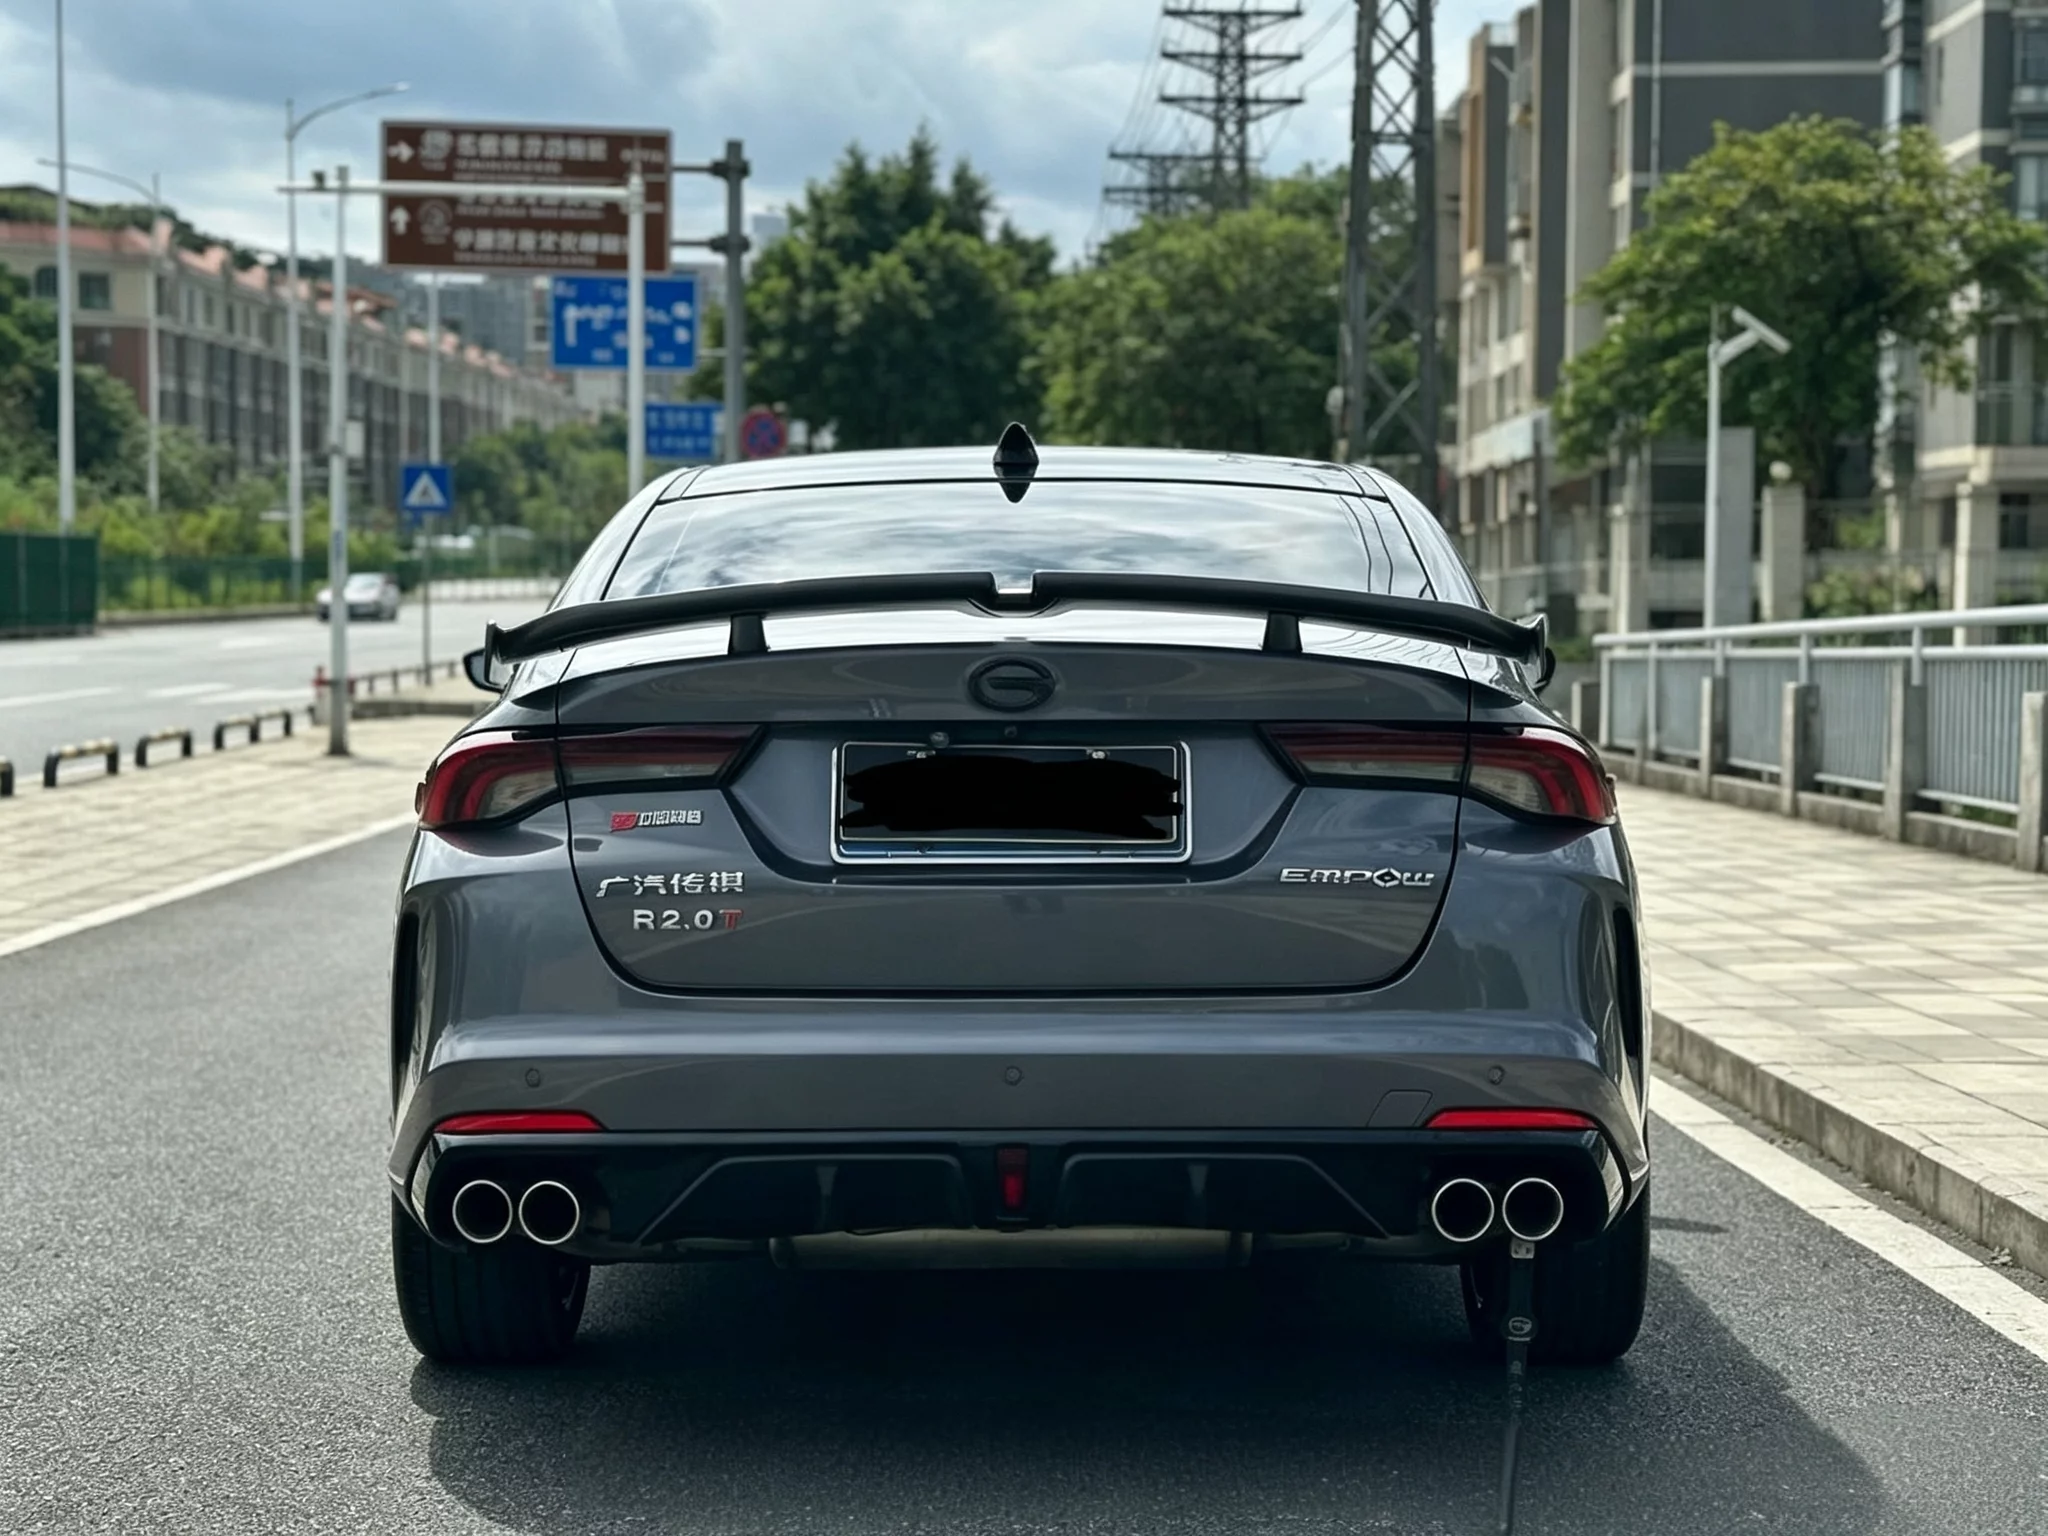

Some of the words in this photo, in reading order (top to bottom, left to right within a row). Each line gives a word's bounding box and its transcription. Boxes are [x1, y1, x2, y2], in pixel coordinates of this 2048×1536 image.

[596, 871, 744, 897] 广汽传祺
[633, 909, 743, 930] R2.0T
